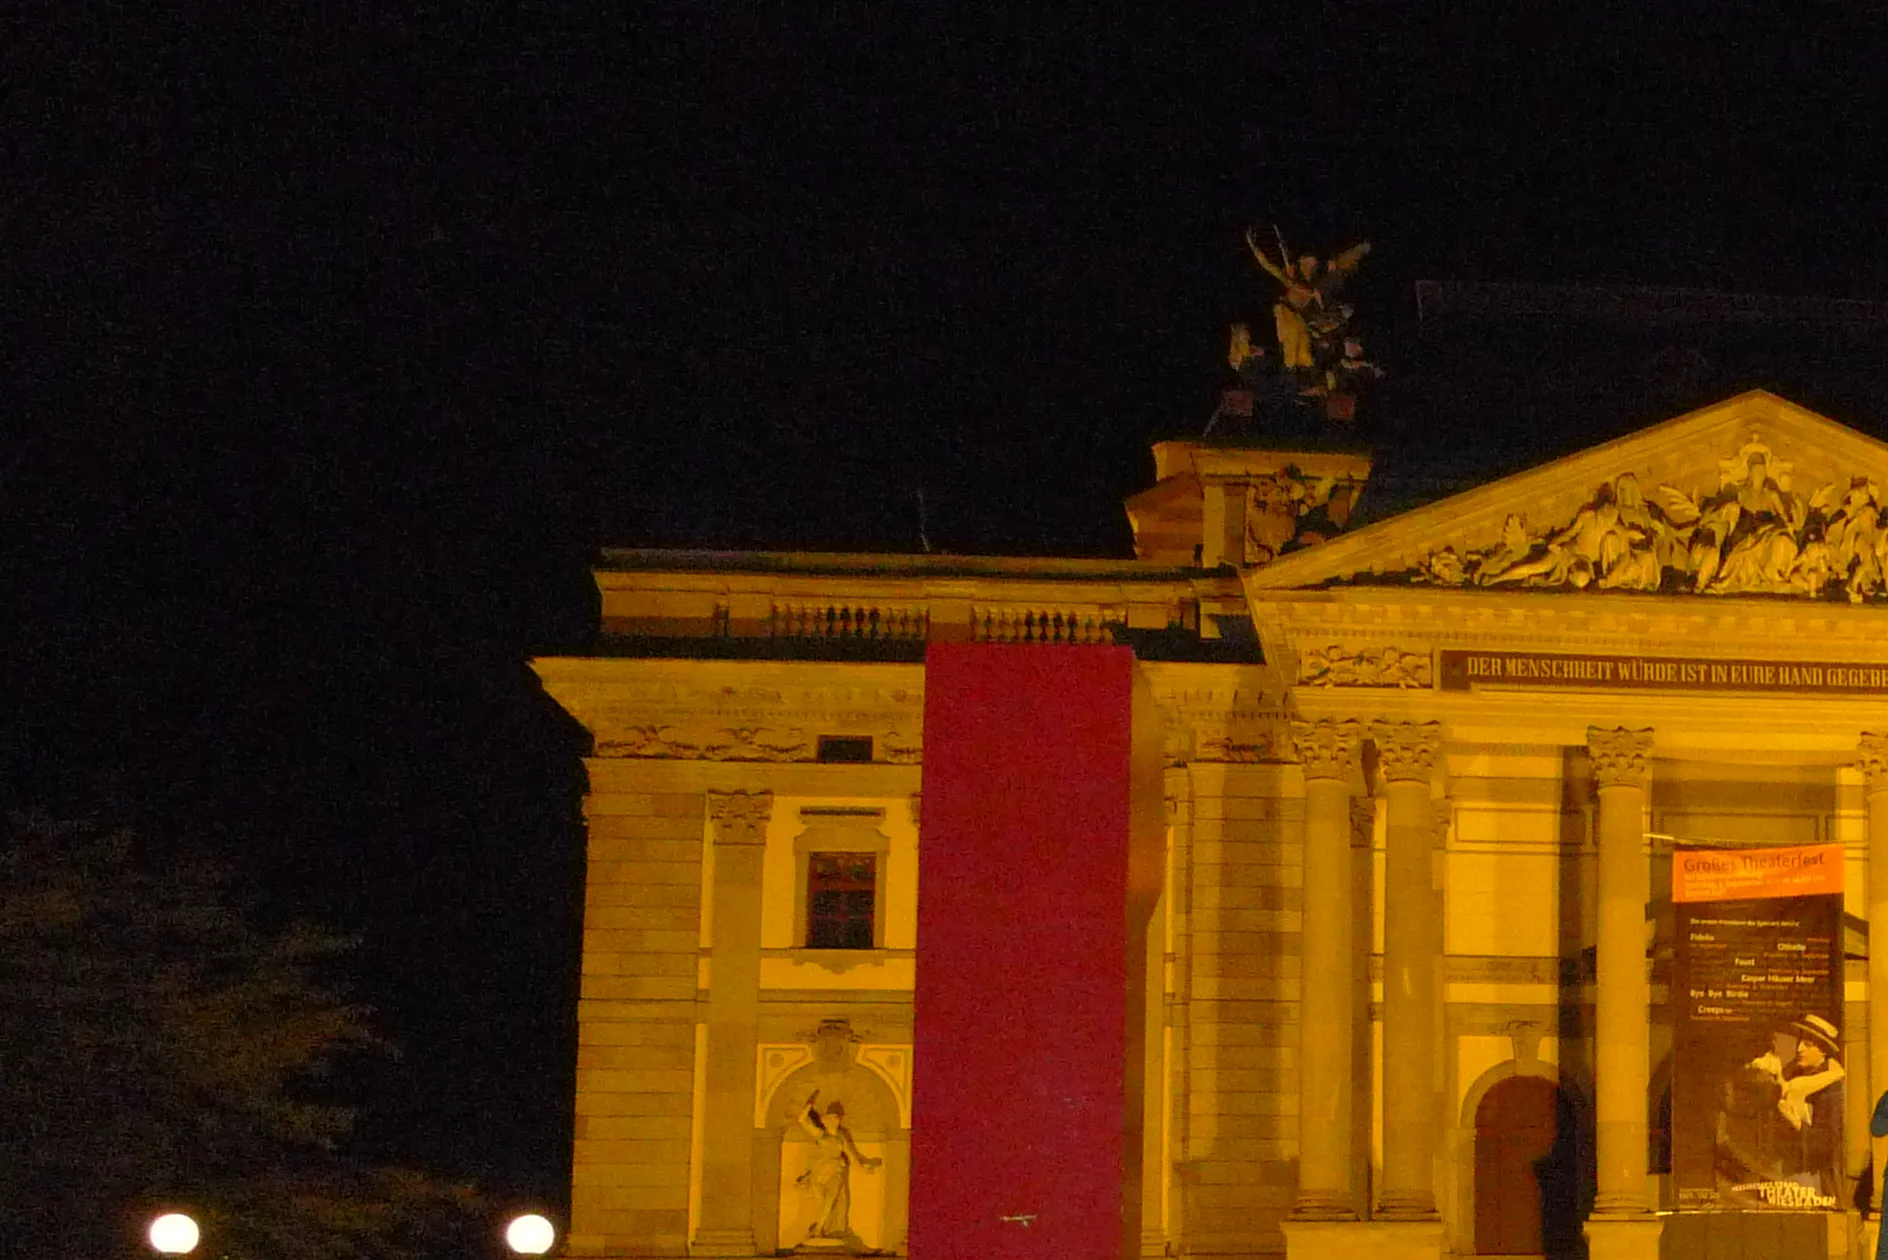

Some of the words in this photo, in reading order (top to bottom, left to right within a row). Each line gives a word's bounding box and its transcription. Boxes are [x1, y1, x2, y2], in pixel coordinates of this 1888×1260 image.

[1467, 656, 1502, 677] DER
[1505, 657, 1614, 681] MENSCHHEIT
[1681, 664, 1708, 683] IST
[1711, 665, 1729, 684] IN
[1731, 665, 1776, 685] EURE
[1779, 666, 1823, 687] HAND
[1683, 858, 1737, 873] Großes
[1740, 852, 1826, 870] Theaterfest
[1760, 1186, 1816, 1199] THEATER
